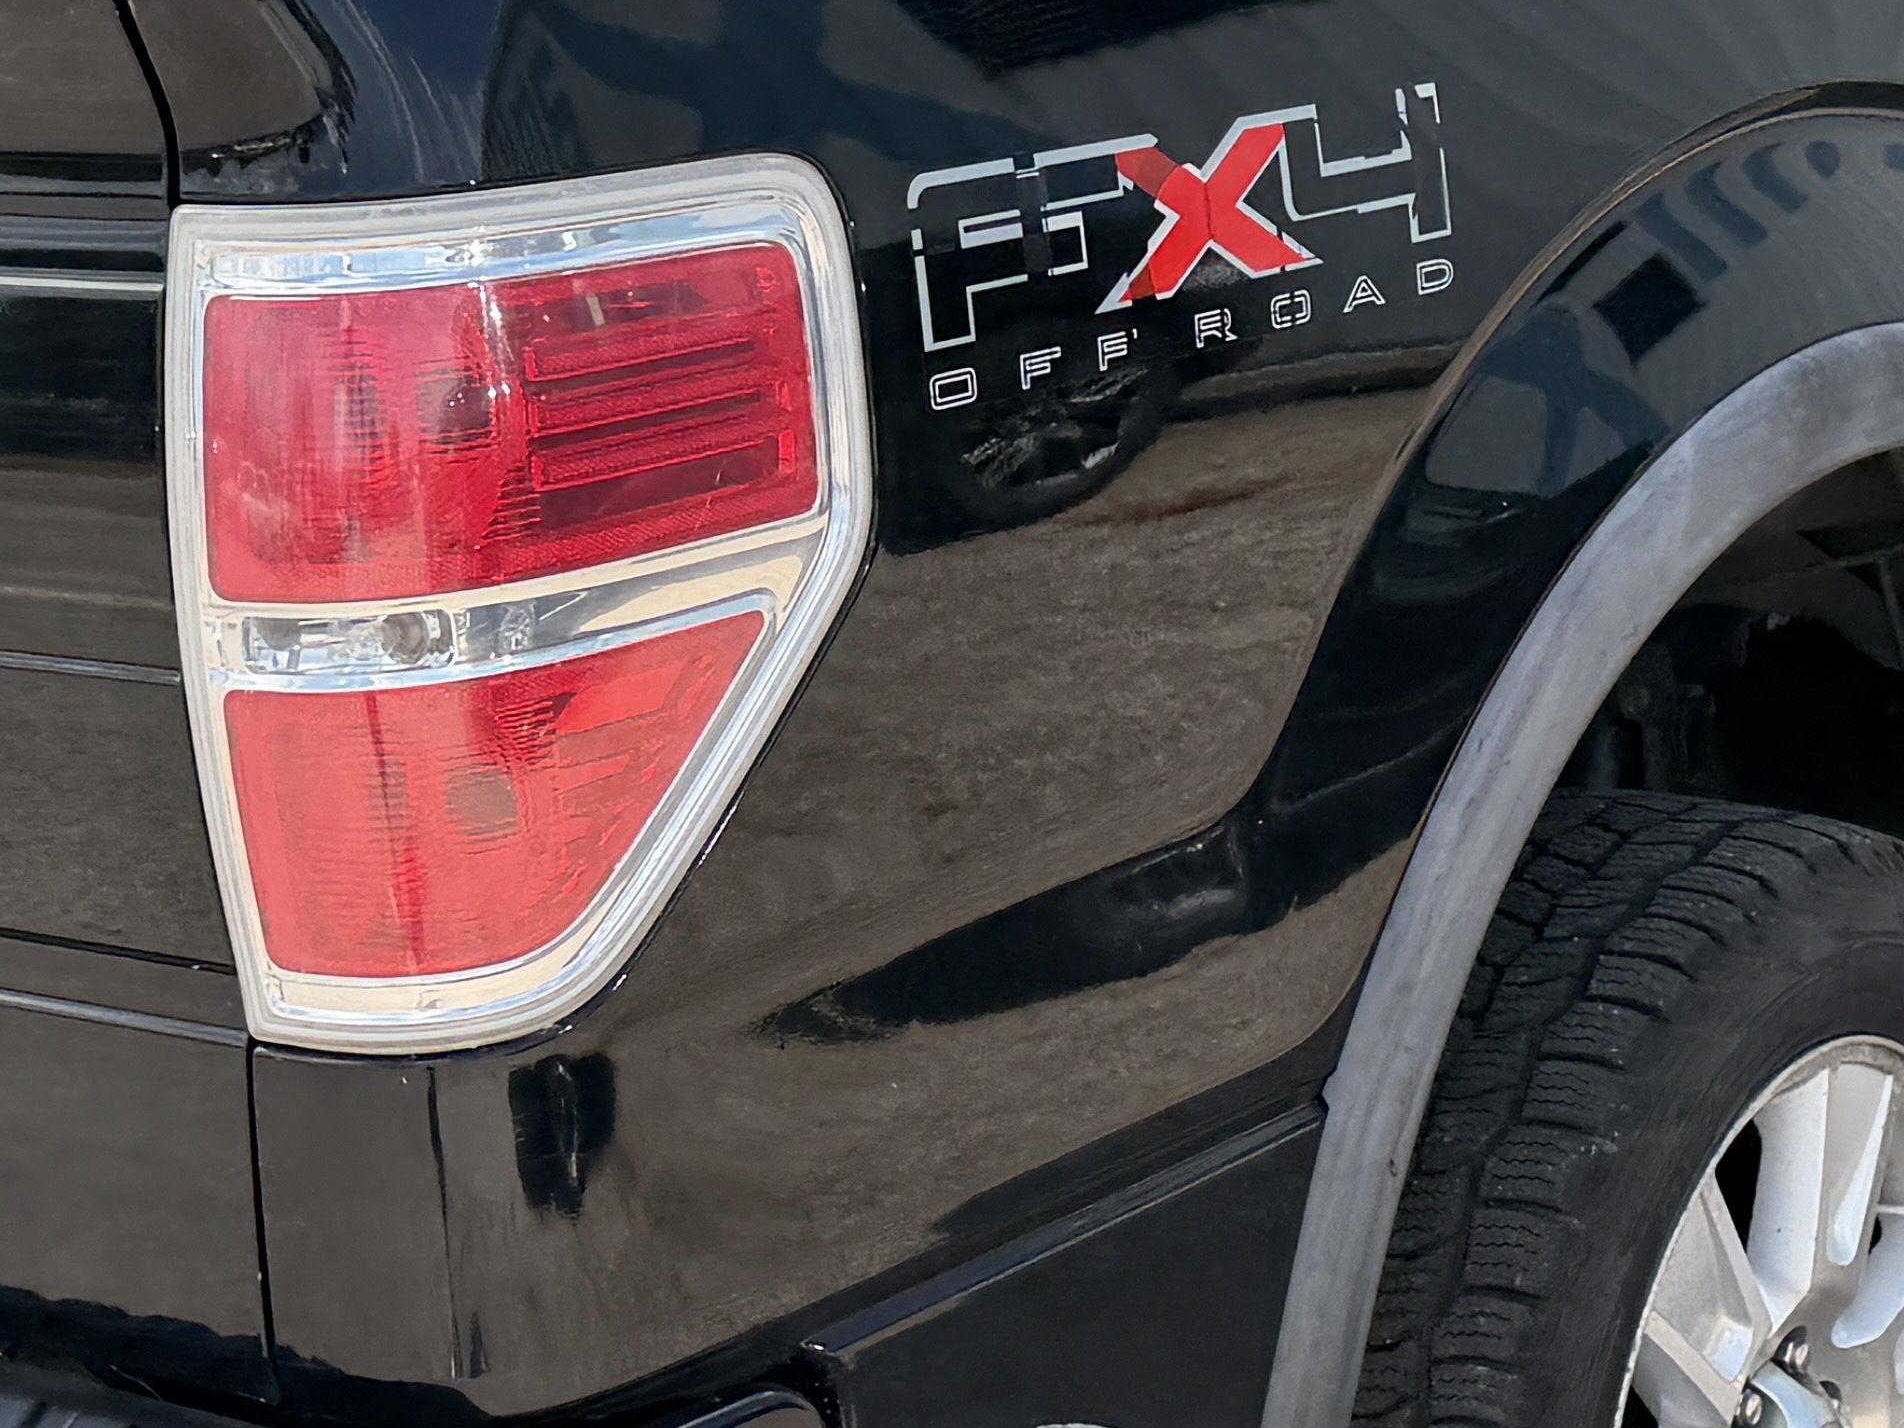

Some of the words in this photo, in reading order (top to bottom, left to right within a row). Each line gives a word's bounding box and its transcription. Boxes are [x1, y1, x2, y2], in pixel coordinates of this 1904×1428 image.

[907, 82, 1453, 353] FX4
[929, 328, 1139, 411] OFF
[1195, 258, 1455, 349] ROAD
